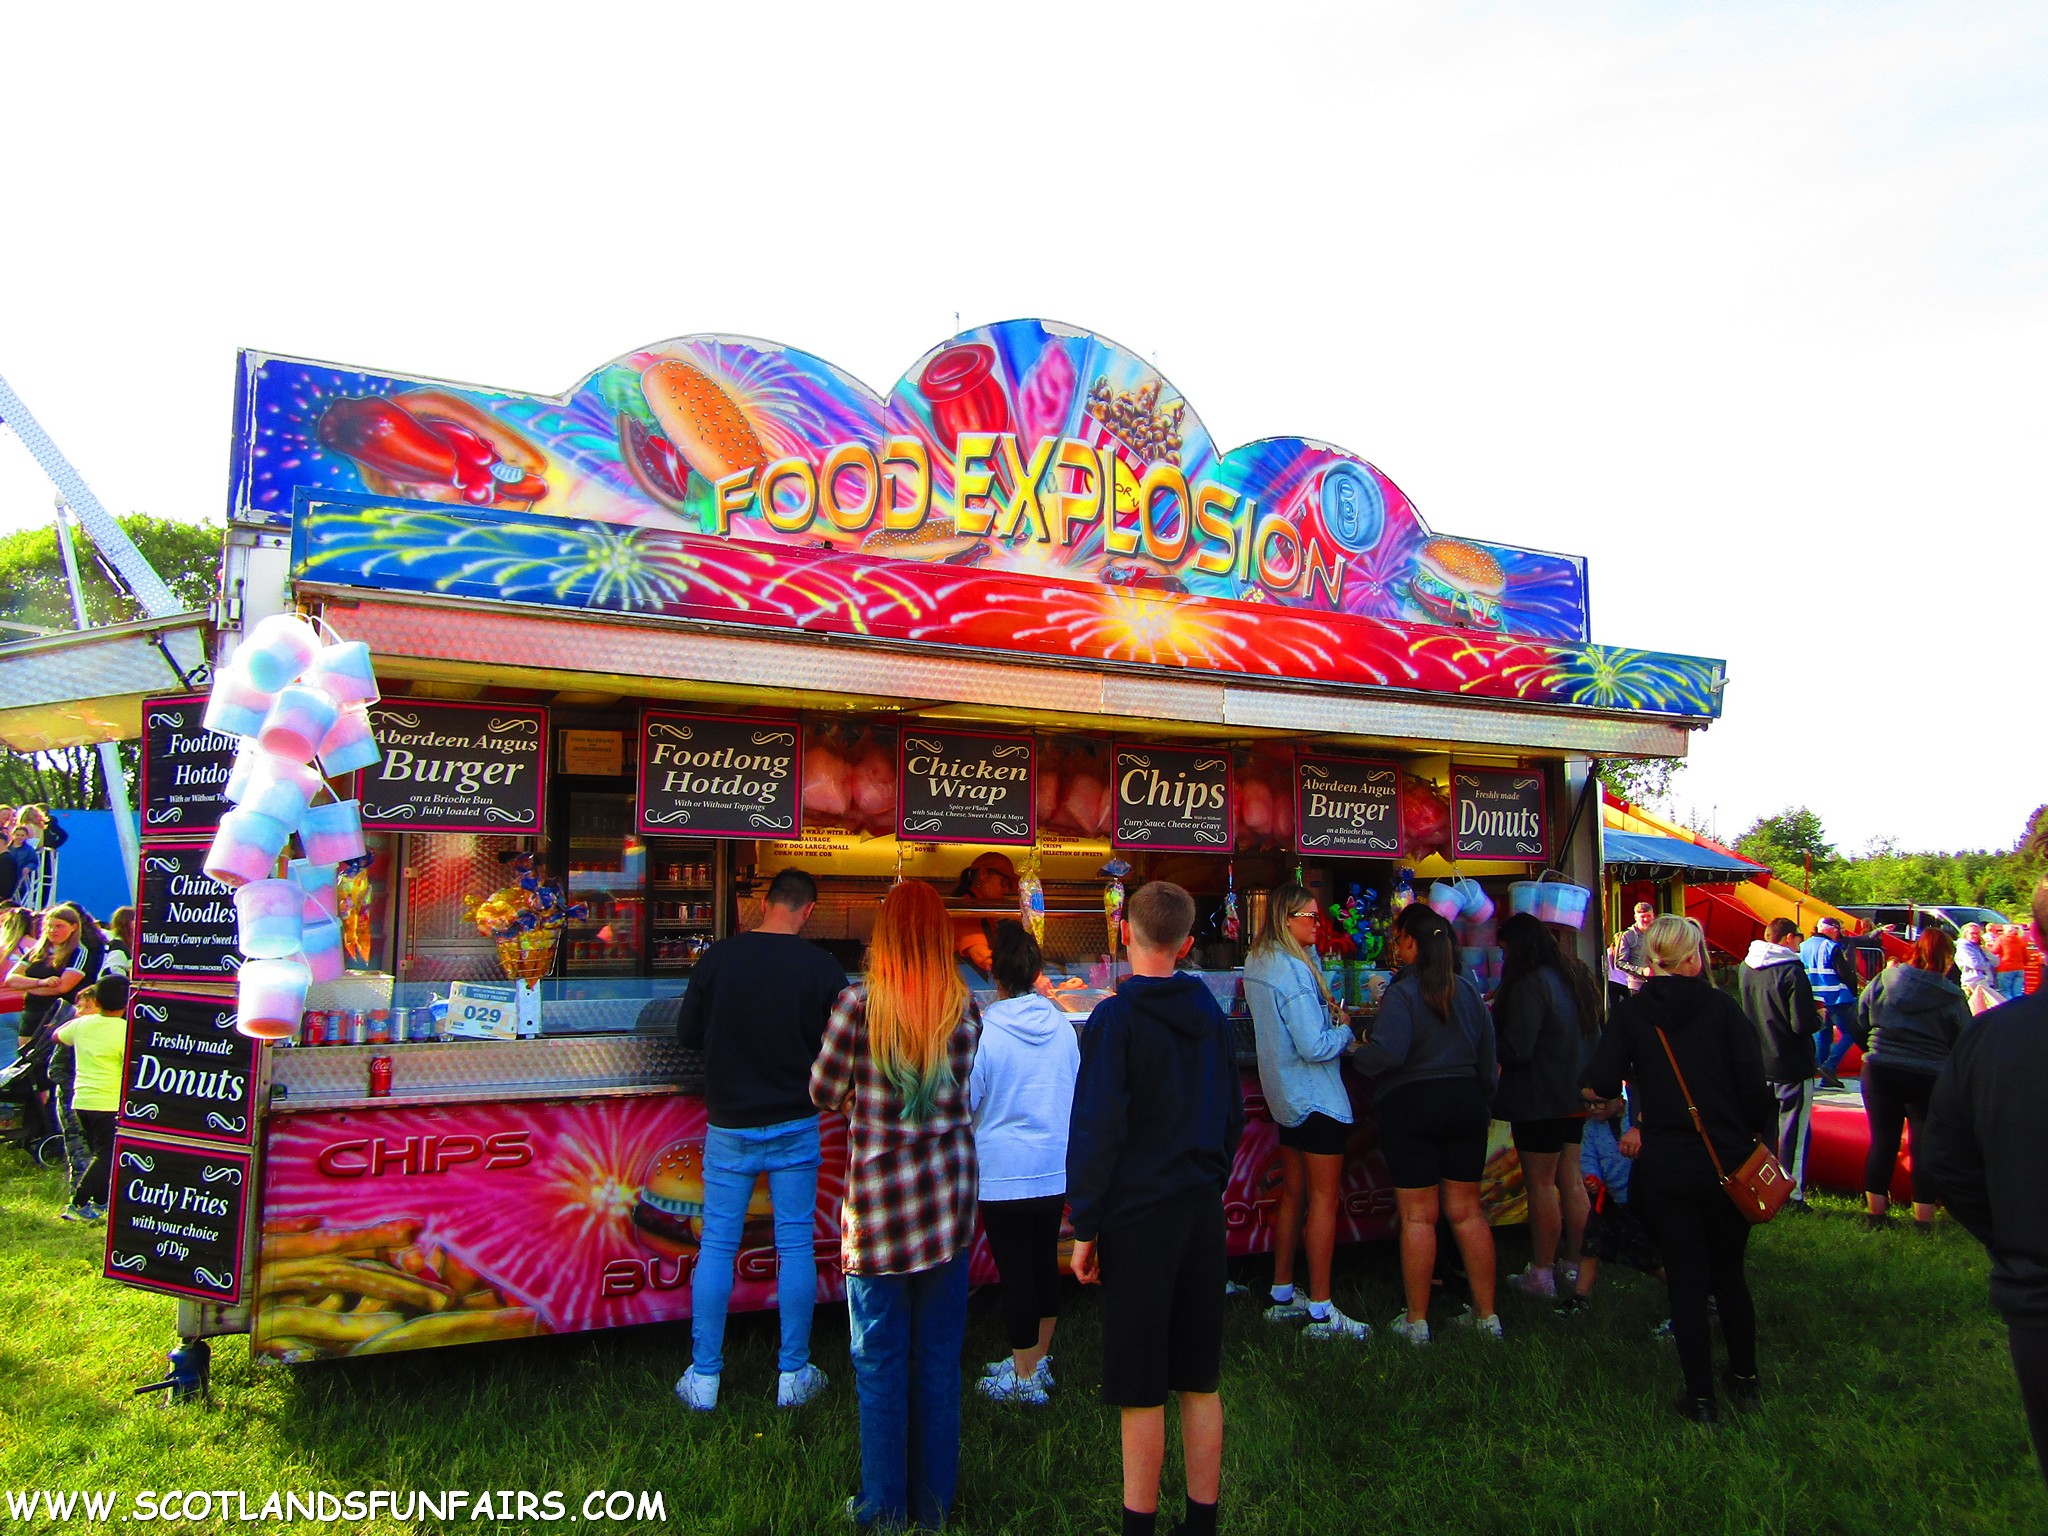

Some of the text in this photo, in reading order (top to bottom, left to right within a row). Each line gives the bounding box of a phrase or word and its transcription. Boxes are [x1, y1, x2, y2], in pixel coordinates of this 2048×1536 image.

[716, 432, 1348, 603] FOOD EXPLOSION
[375, 729, 538, 755] Aberdeen Angus
[378, 749, 525, 794] Burger
[651, 743, 791, 779] Footlong
[907, 756, 1028, 781] Chicken
[175, 763, 235, 786] Hotdo
[661, 770, 779, 804] Hotdog
[410, 795, 422, 803] on
[432, 794, 471, 805] Brioche
[472, 795, 493, 805] Bun
[927, 777, 1007, 806] Wrap
[1120, 768, 1226, 820] Chips
[1302, 778, 1396, 798] Aberdeen Angus
[1475, 790, 1520, 802] Freshly made
[420, 806, 481, 818] fully loaded
[674, 799, 692, 807] With
[703, 800, 732, 809] Without
[733, 801, 765, 812] Toppings
[1007, 814, 1024, 822] Mayo
[1308, 793, 1390, 828] Burger
[1124, 818, 1144, 829] Curry
[1144, 819, 1166, 828] Sauce,
[1167, 820, 1191, 829] Cheese
[1200, 821, 1221, 831] Gravy
[1459, 799, 1539, 838] Donuts
[1333, 837, 1346, 845] fully
[1339, 827, 1361, 836] Brioche
[166, 902, 237, 923] Noodles
[142, 932, 159, 944] With
[181, 933, 202, 948] Gravy
[202, 936, 211, 945] or
[211, 934, 232, 945] Sweet
[232, 934, 238, 945] &
[464, 1005, 501, 1023] 029
[151, 1031, 234, 1056] Freshly made
[134, 1054, 245, 1102] Donuts
[317, 1130, 534, 1178] CHIPS
[128, 1178, 229, 1217] Curly Fries
[131, 1214, 219, 1242] with your choice
[156, 1239, 190, 1261] of Dip
